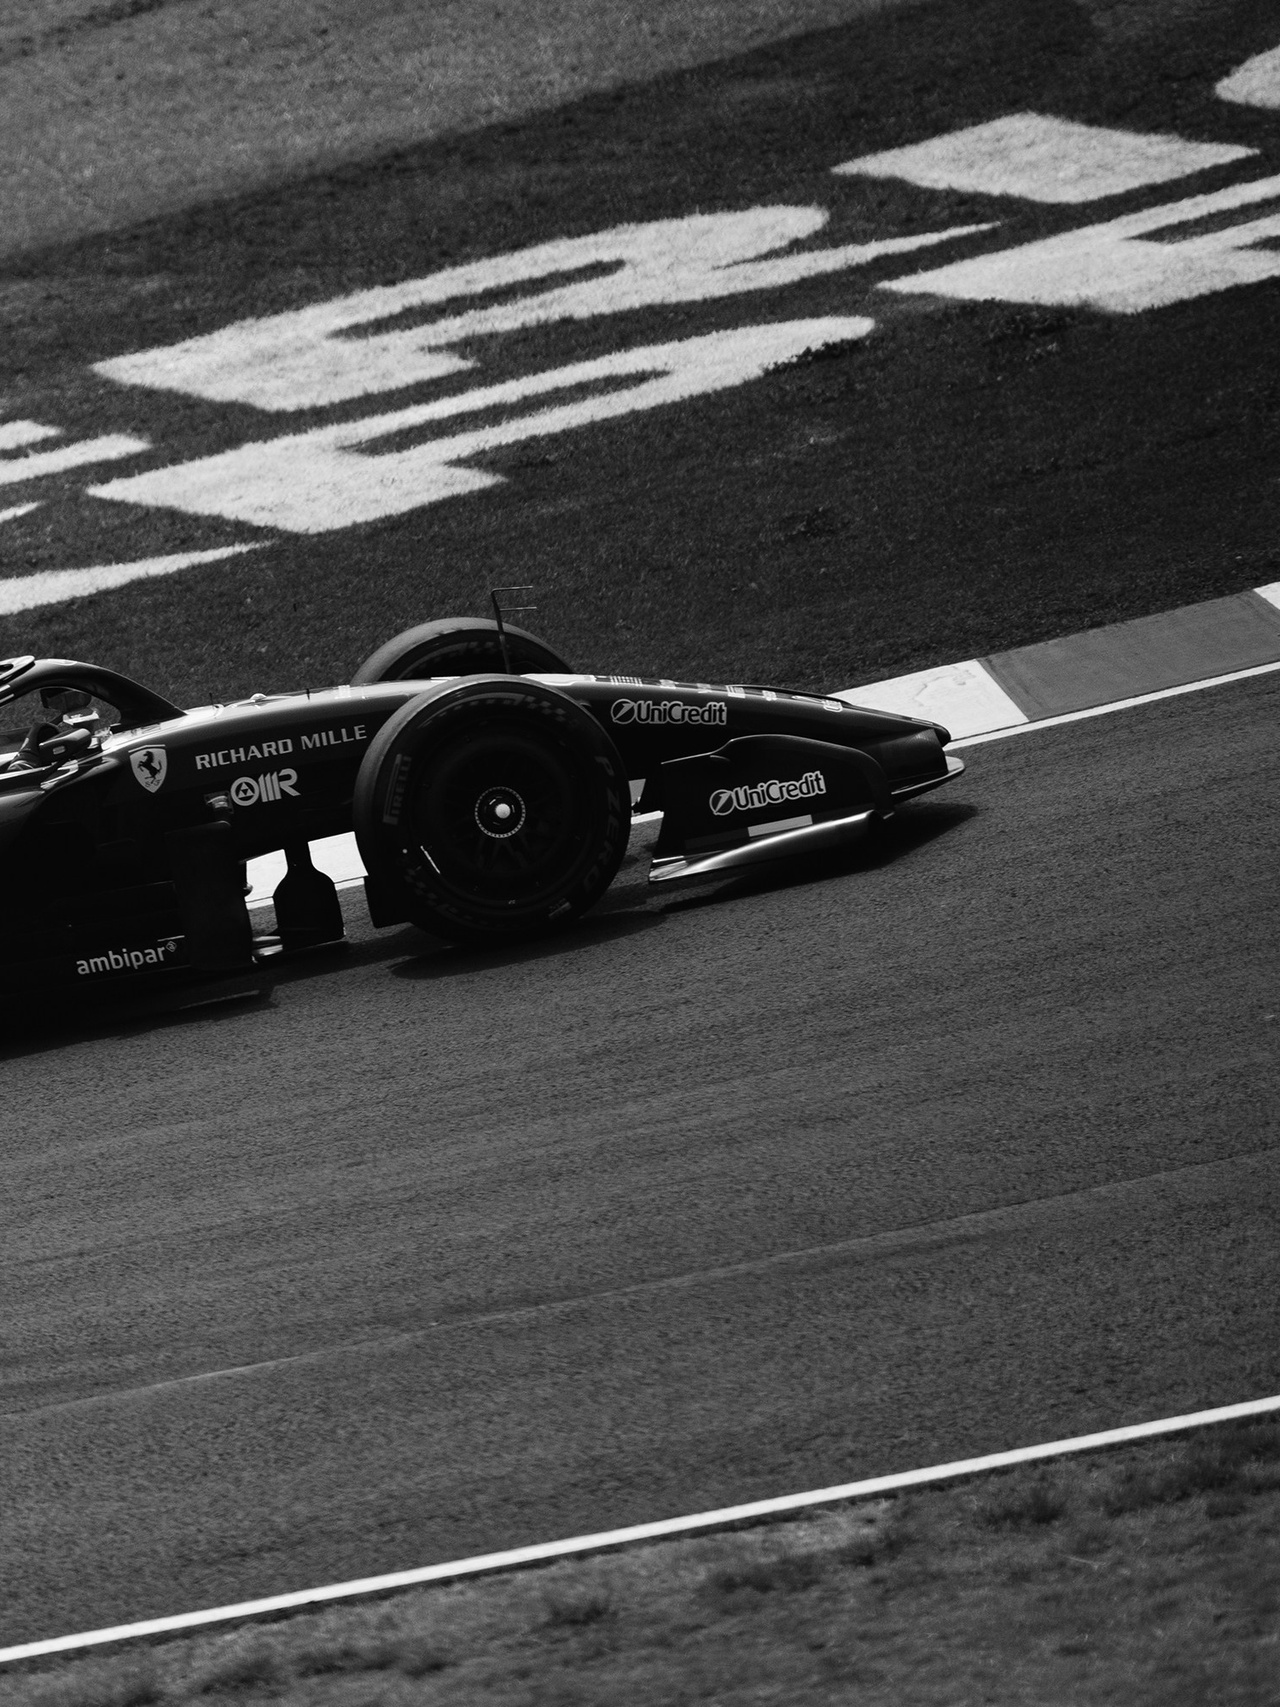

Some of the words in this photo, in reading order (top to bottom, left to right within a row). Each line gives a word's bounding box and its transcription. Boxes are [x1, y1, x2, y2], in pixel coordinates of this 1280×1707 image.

[636, 701, 727, 725] UniCredit
[195, 738, 293, 770] RICHARD
[300, 724, 367, 751] MILLE
[383, 753, 412, 825] PIRELLI
[735, 771, 826, 811] UniCredit
[582, 786, 620, 892] ZERO
[76, 946, 165, 975] ambipar
